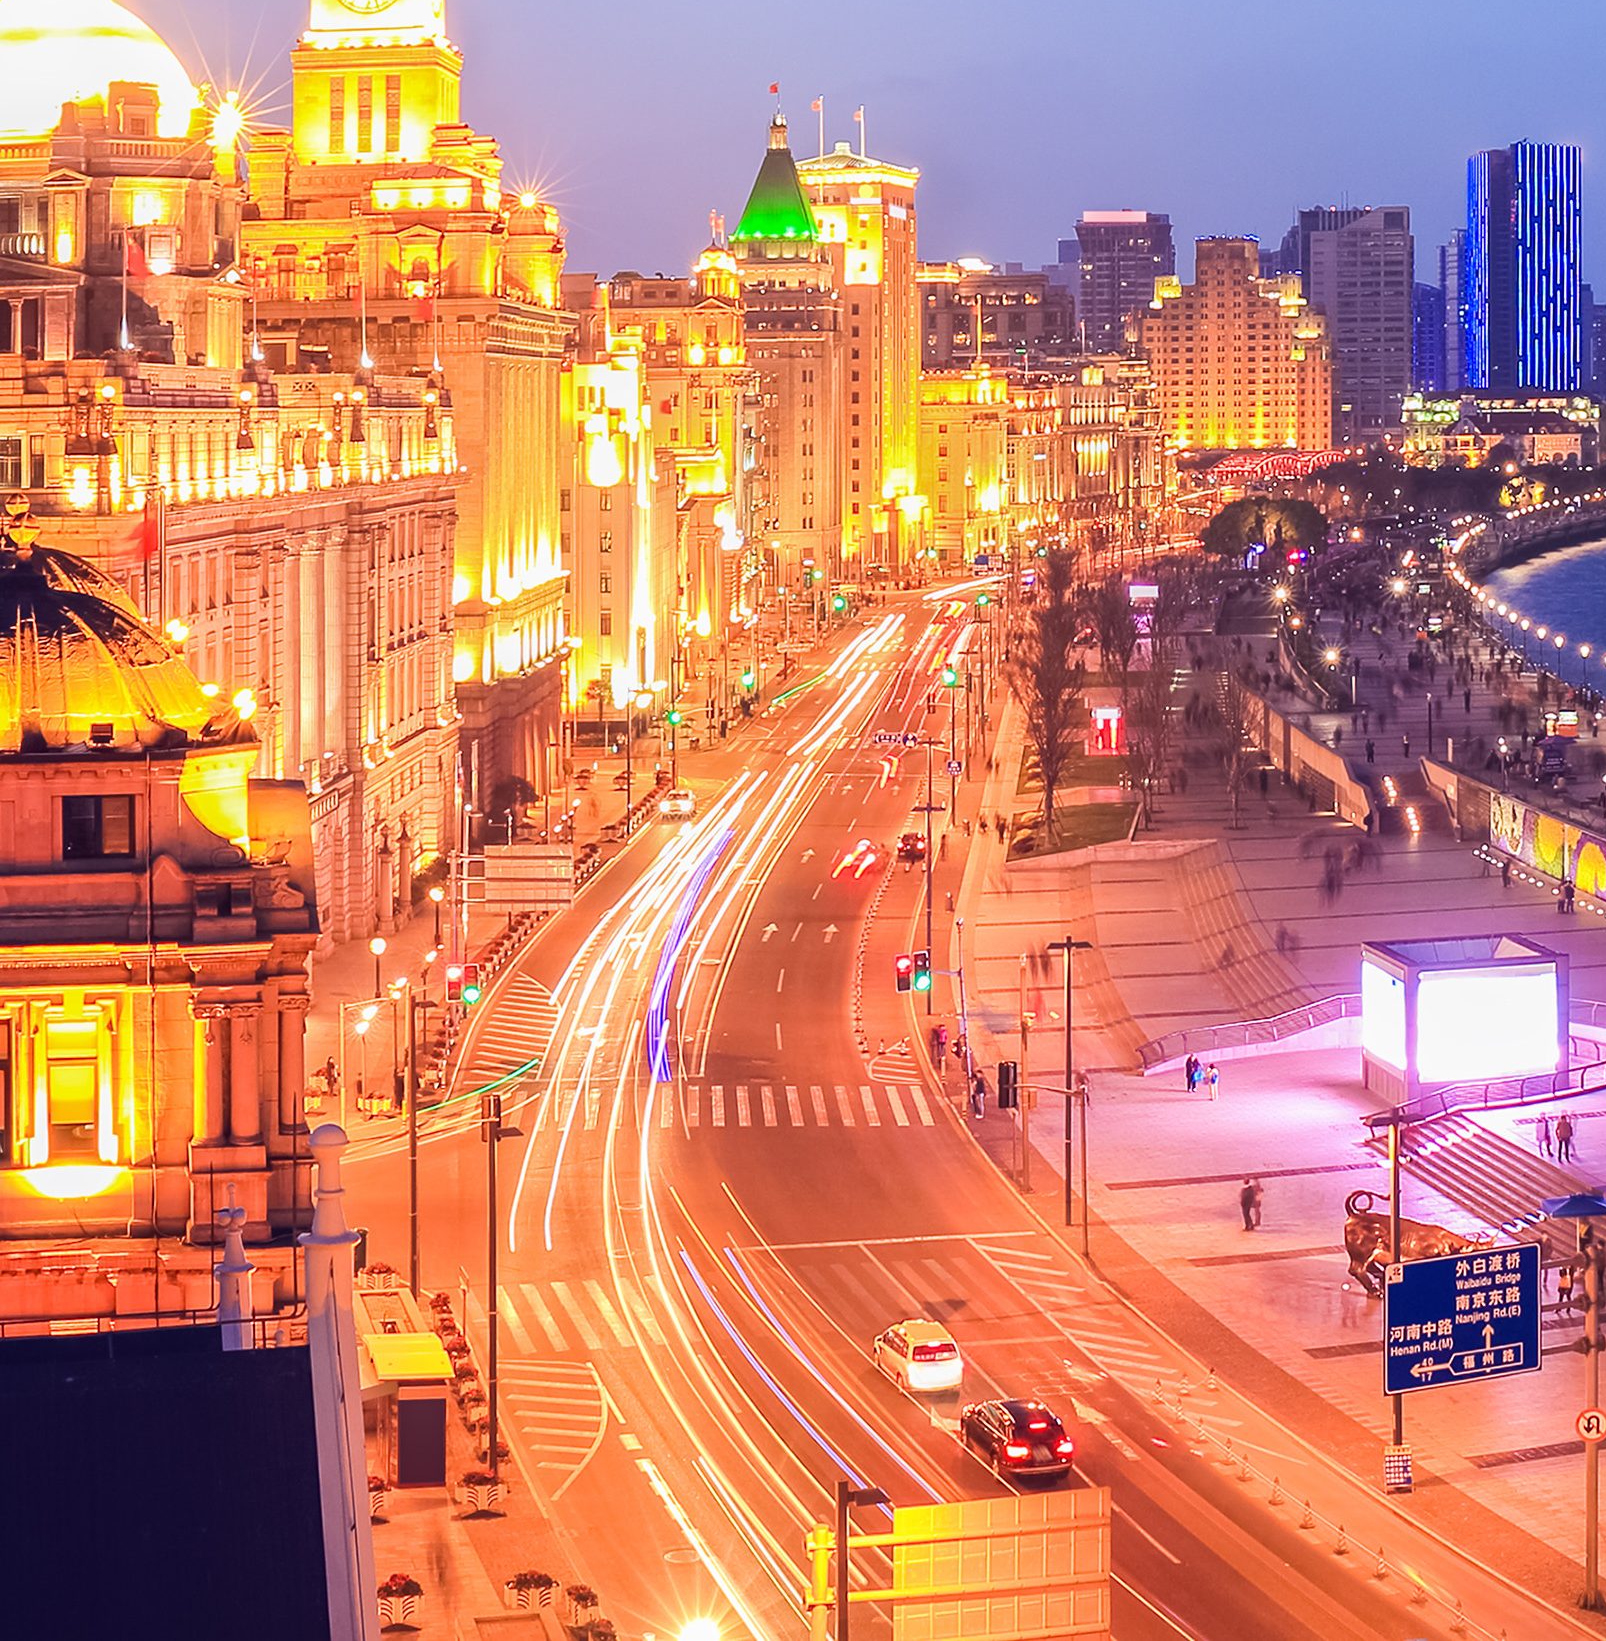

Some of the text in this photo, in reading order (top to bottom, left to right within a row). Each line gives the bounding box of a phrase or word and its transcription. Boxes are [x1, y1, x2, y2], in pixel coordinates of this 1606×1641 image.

[1456, 1252, 1521, 1277] 外白渡桥
[1456, 1273, 1521, 1290] Waibaidu Bridge
[1456, 1287, 1521, 1311] 南京东路
[1455, 1305, 1521, 1324] Nanjing Rd.(E)
[1390, 1319, 1453, 1343] 河南中路
[1391, 1338, 1454, 1357] Henan Rd.(M)
[1421, 1357, 1434, 1366] 40
[1463, 1349, 1515, 1369] 福州路
[1421, 1372, 1432, 1382] 17
